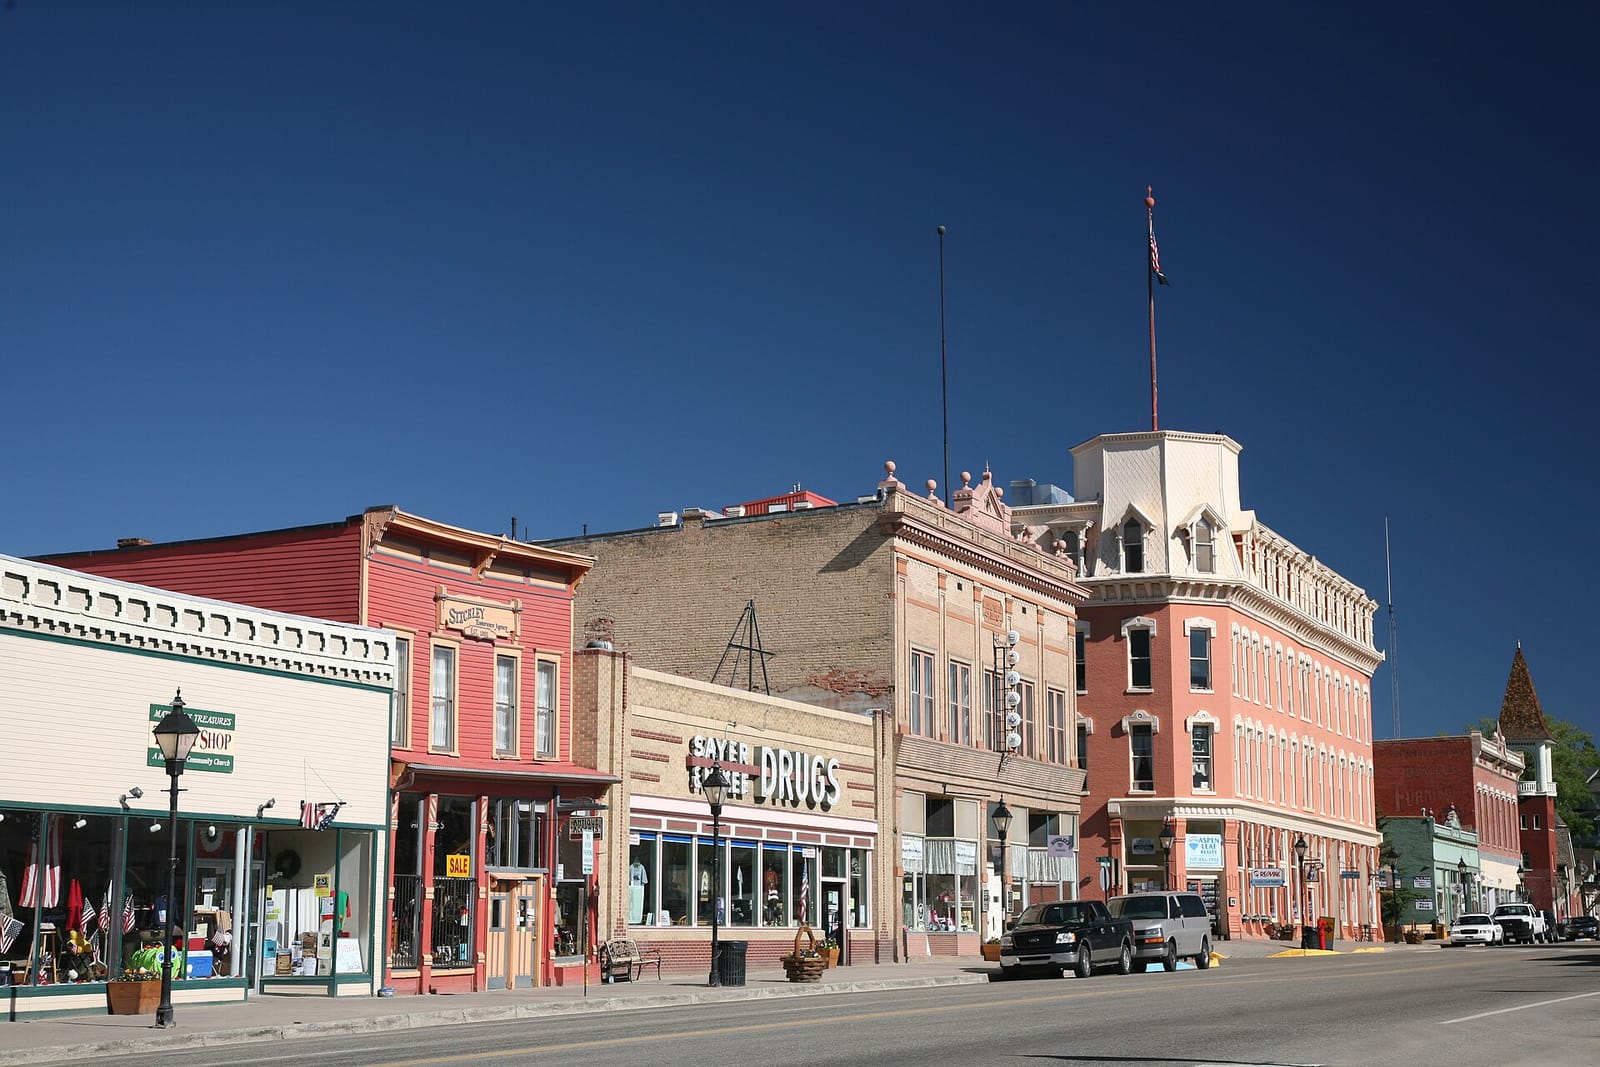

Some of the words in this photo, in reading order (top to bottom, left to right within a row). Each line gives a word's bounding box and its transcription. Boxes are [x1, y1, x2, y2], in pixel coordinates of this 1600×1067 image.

[194, 714, 231, 726] TREASURES
[199, 729, 231, 750] SHOP
[692, 735, 749, 765] SAYER
[213, 758, 230, 767] Church
[760, 746, 841, 806] DRUGS
[449, 857, 468, 874] SALE
